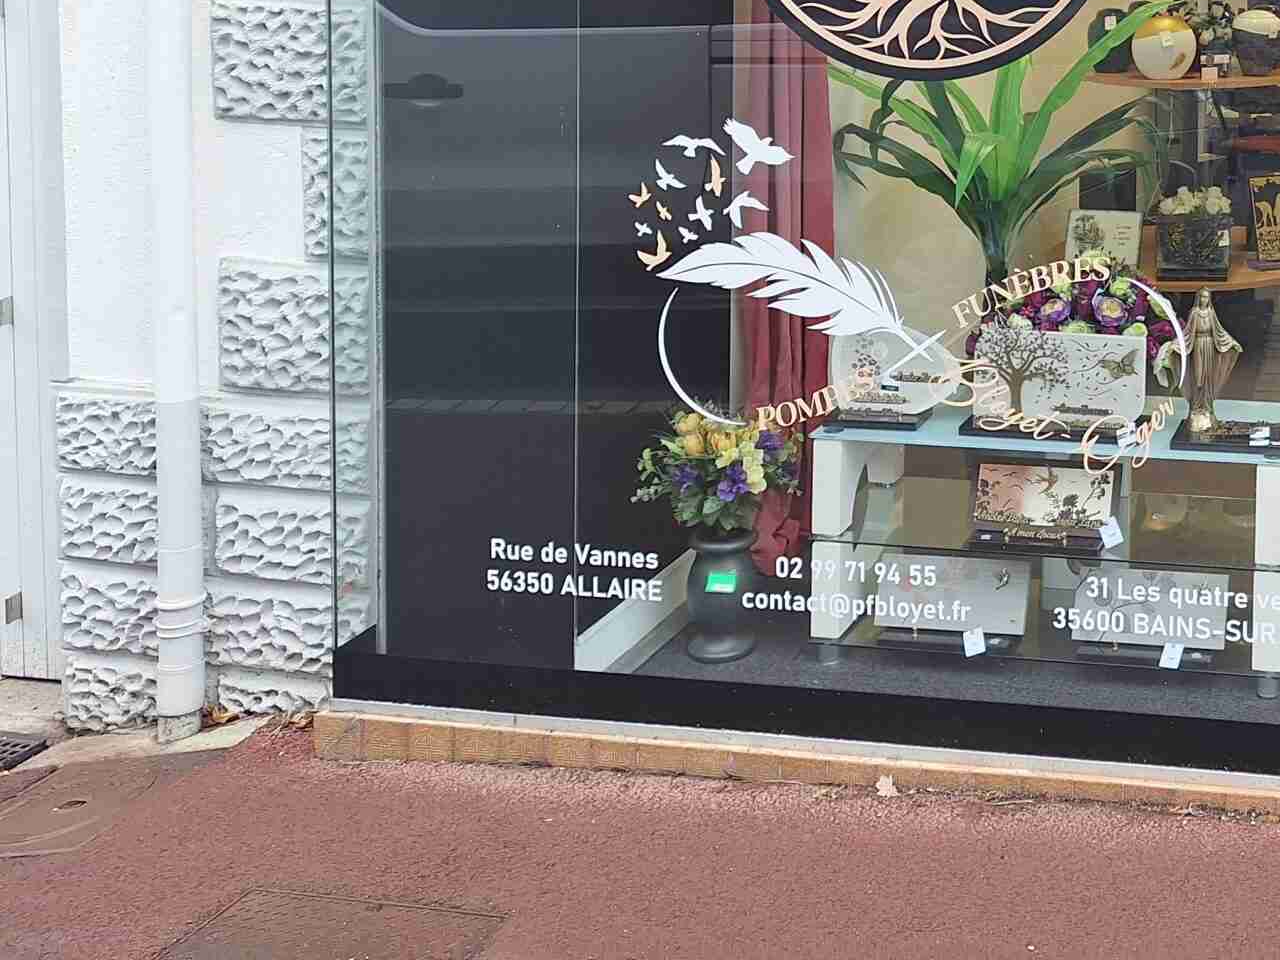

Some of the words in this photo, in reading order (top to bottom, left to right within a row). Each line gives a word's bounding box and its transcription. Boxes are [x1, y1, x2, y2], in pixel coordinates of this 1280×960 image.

[952, 256, 1110, 328] FUNÈBRES
[490, 538, 533, 561] Rue
[541, 542, 567, 563] de
[574, 544, 658, 569] Vannes
[487, 569, 553, 594] 56350
[560, 575, 662, 602] ALLAIRE
[776, 556, 802, 578] 02
[810, 560, 835, 581] 99
[845, 561, 865, 582] 71
[874, 563, 900, 584] 94
[909, 565, 936, 585] 55
[742, 589, 971, 625] contact@pfbloyet.fr
[1086, 576, 1108, 599] 31
[1118, 581, 1159, 603] Les
[1170, 584, 1248, 611] quatre
[1053, 608, 1124, 633] 35600
